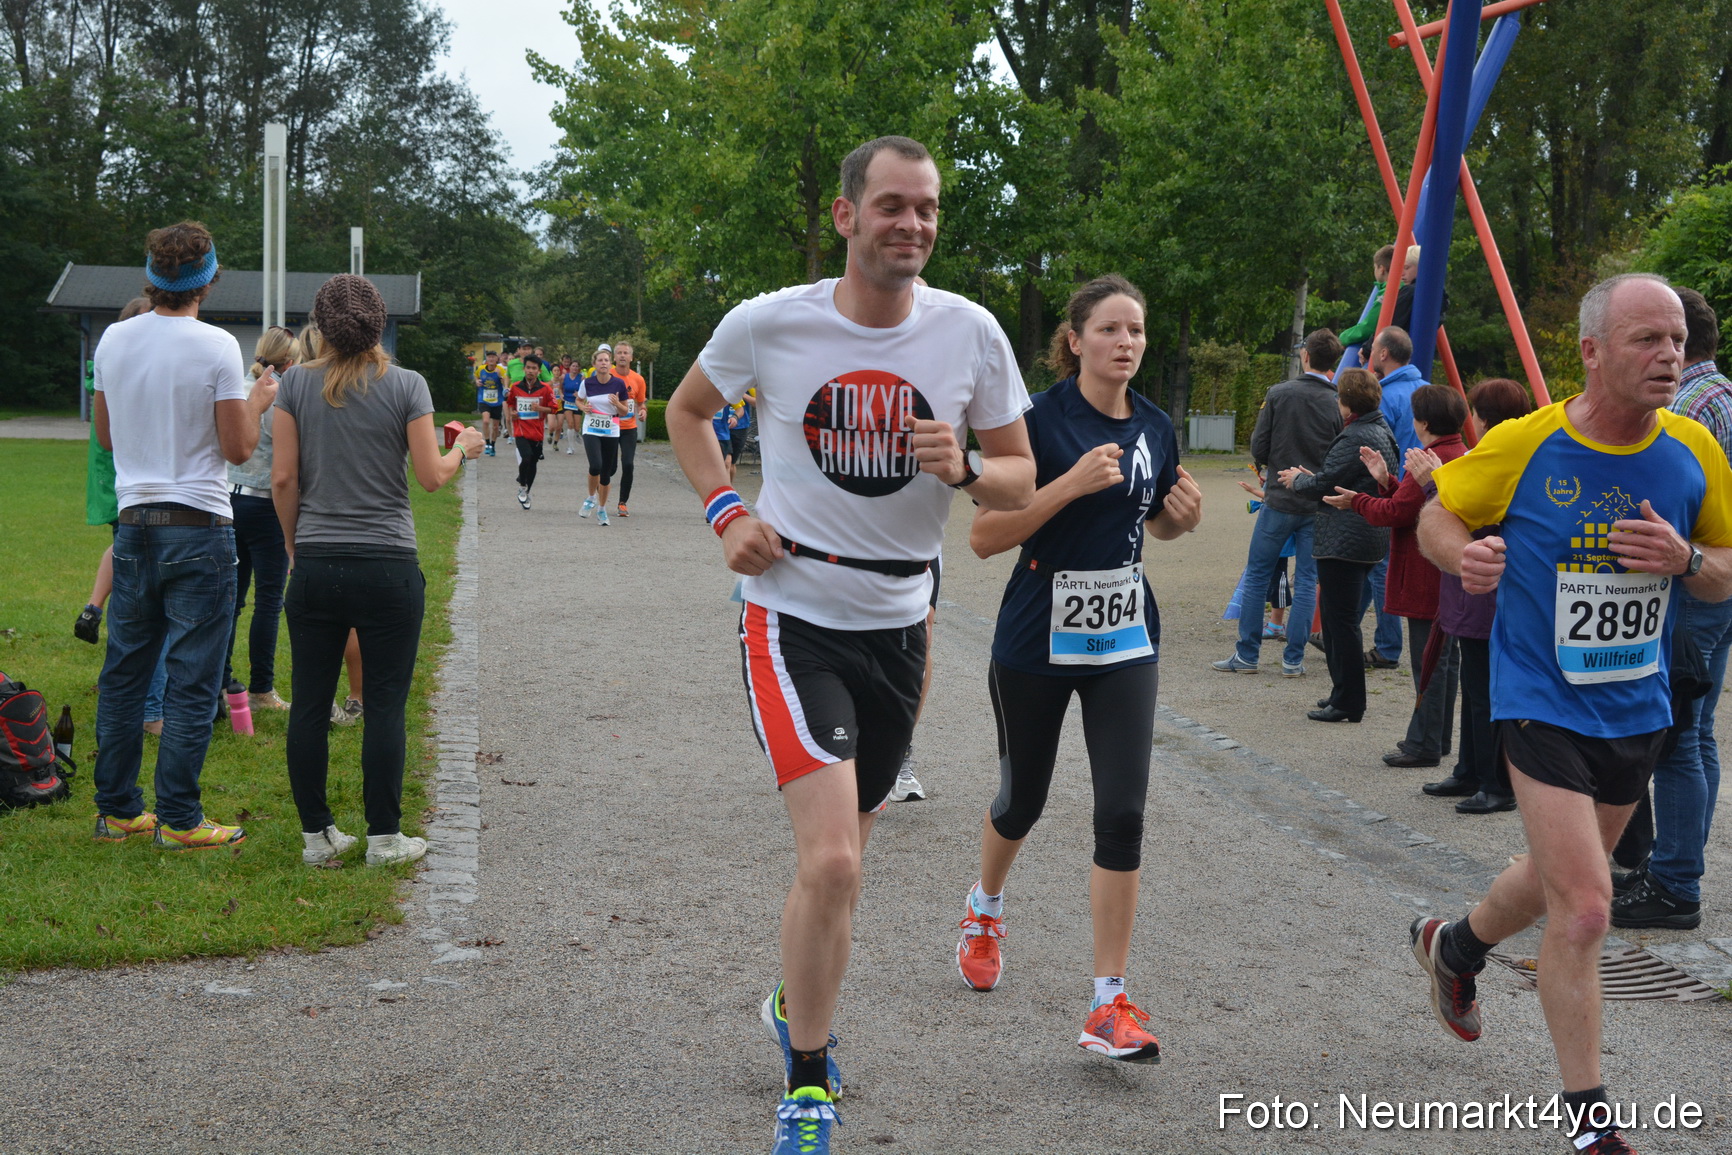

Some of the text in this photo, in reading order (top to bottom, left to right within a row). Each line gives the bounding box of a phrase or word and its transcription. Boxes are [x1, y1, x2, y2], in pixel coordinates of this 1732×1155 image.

[519, 403, 533, 412] 244
[828, 383, 913, 431] TOKYO
[590, 418, 611, 428] 2918
[133, 511, 171, 525] PMA
[1055, 580, 1092, 590] PARTL
[1094, 576, 1132, 590] Neumarkt
[1560, 582, 1602, 595] PARTL
[1605, 583, 1657, 595] Neumarkt
[1063, 588, 1137, 630] 2364
[1568, 597, 1661, 642] 2898
[1086, 638, 1116, 652] Stine
[1583, 648, 1645, 669] Willfried
